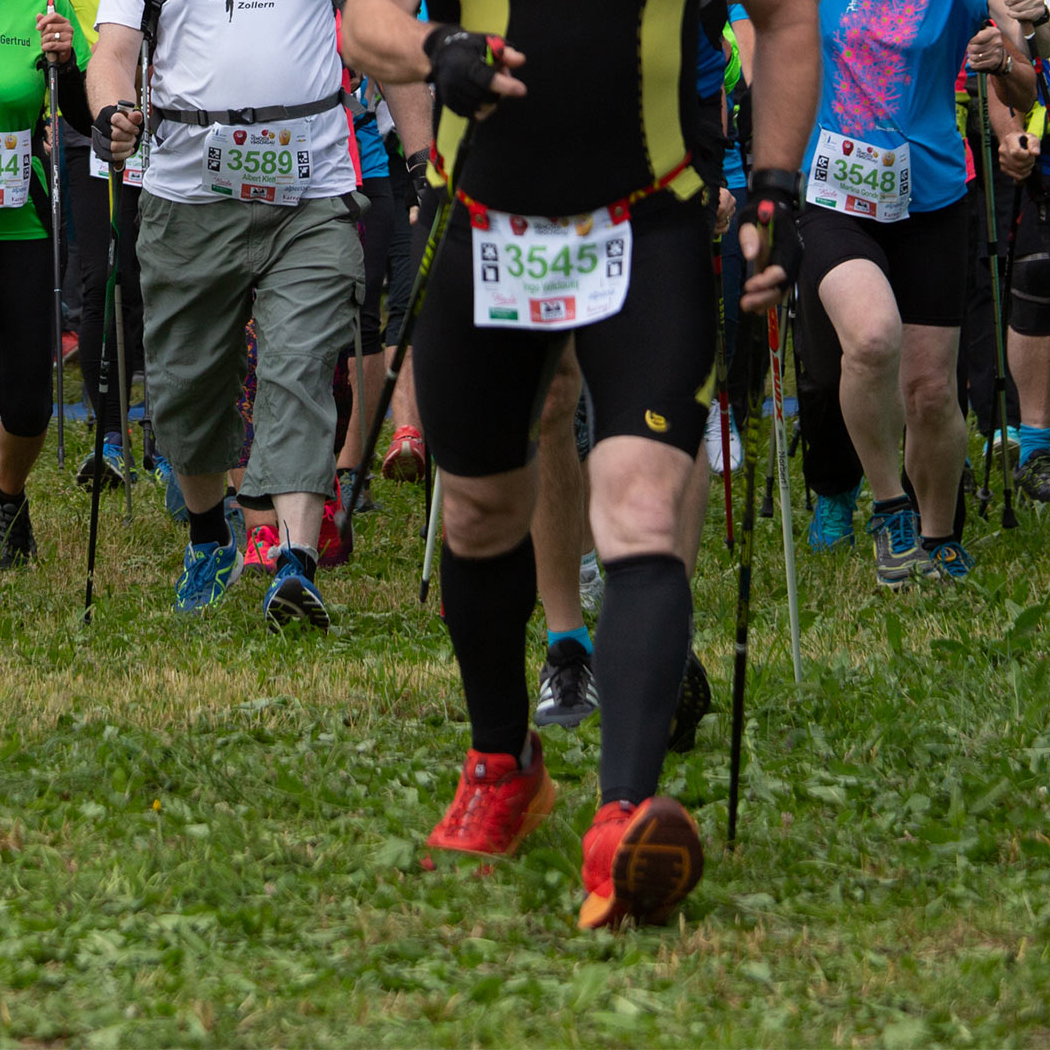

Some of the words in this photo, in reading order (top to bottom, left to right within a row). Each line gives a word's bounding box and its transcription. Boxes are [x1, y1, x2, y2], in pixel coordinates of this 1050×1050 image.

[237, 1, 275, 10] Zollern
[0, 34, 31, 47] Gertrud
[227, 149, 293, 175] 3589
[833, 159, 896, 193] 3548
[505, 243, 598, 279] 3545
